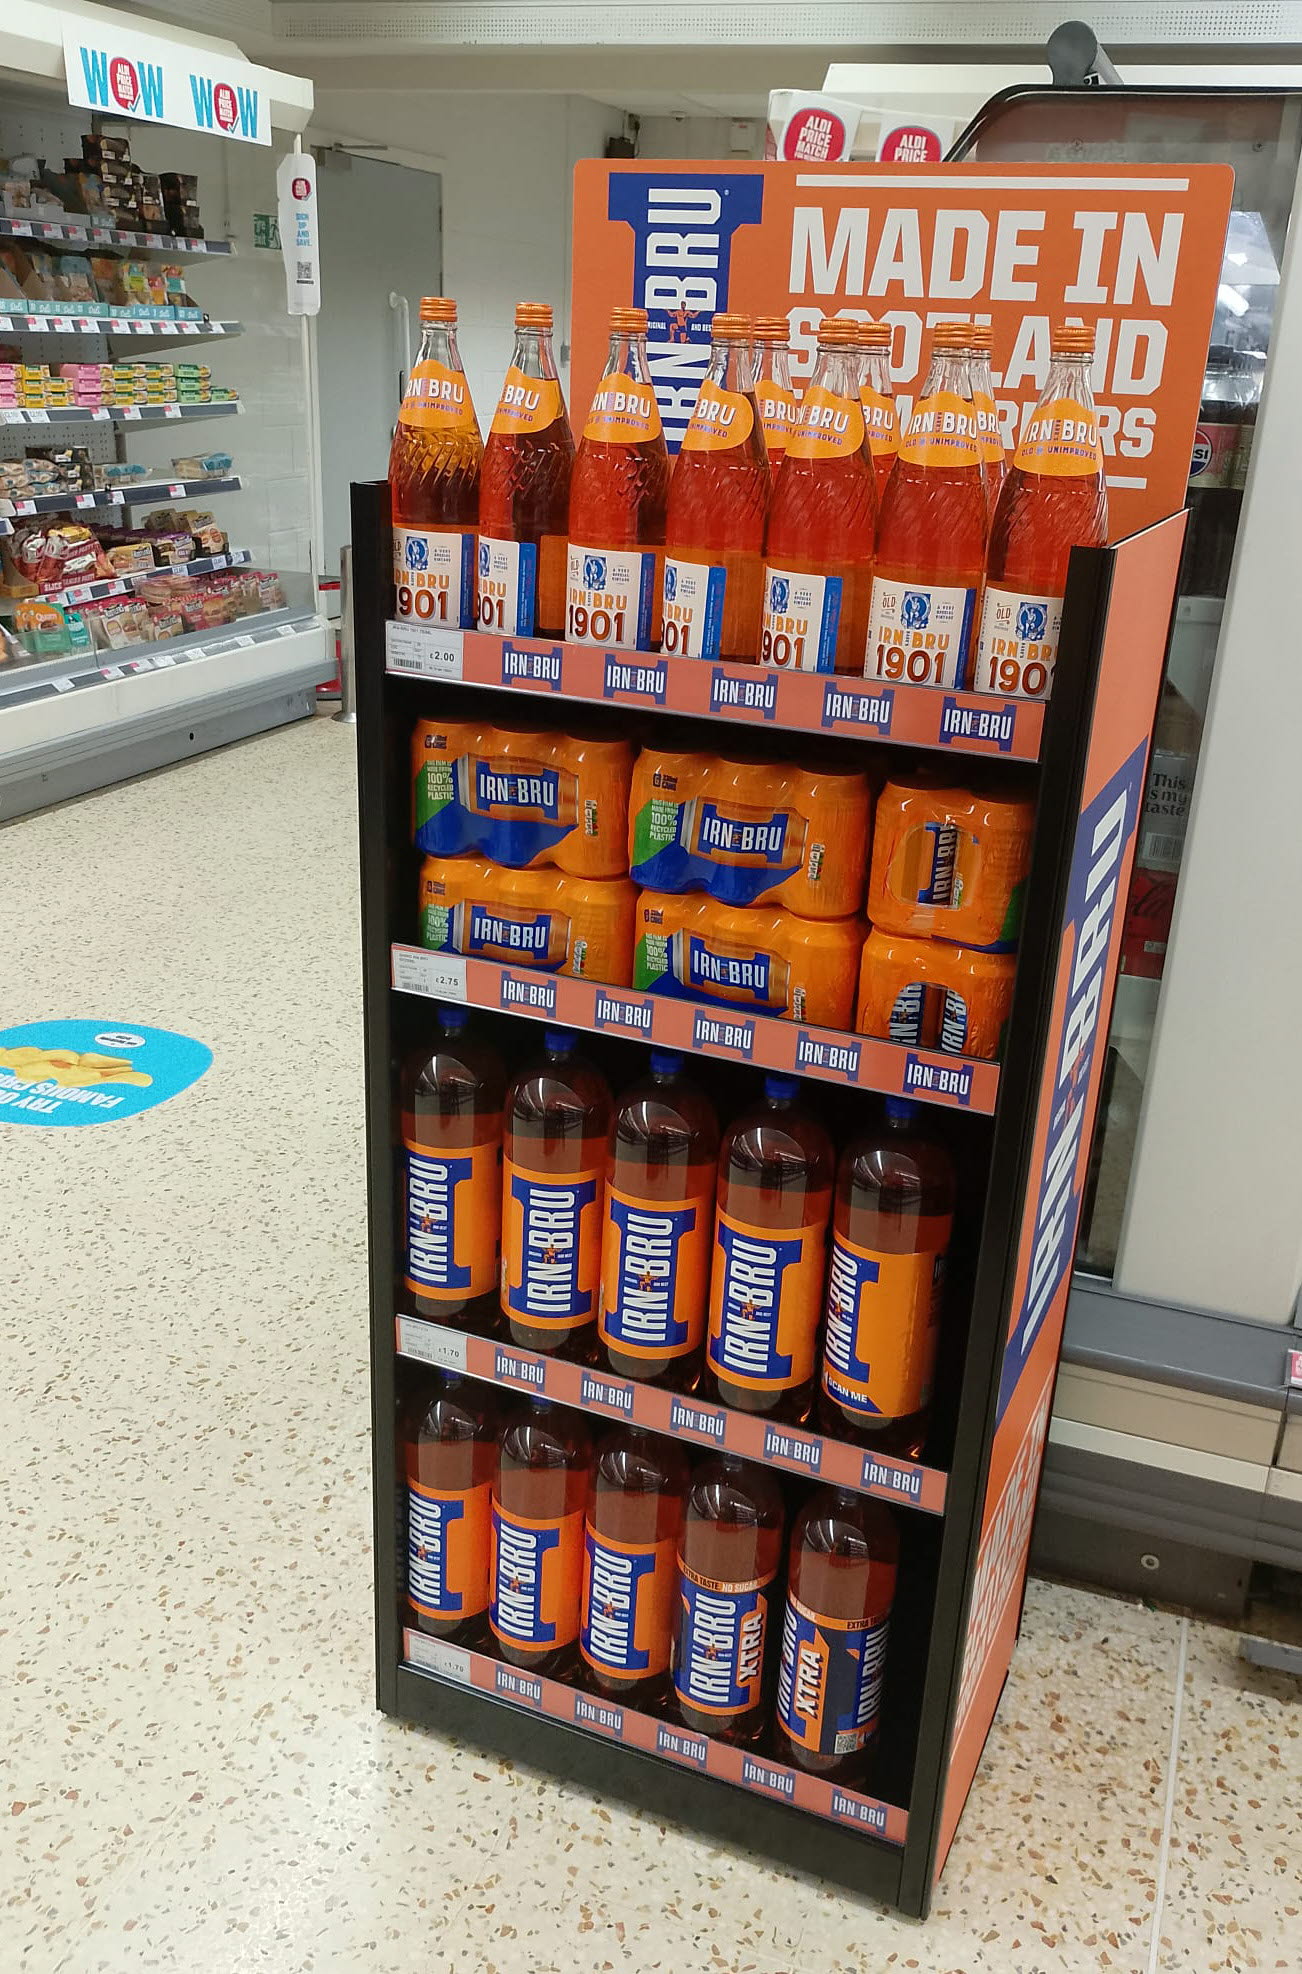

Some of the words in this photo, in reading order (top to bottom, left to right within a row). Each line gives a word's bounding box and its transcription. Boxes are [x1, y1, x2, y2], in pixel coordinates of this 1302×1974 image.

[799, 127, 833, 148] PRICE
[805, 116, 832, 133] ALDI
[796, 141, 829, 160] MATCH
[894, 147, 928, 162] PRICE
[899, 134, 927, 150] ALDI
[645, 188, 722, 311] BRU
[788, 207, 1046, 301] MADE
[1064, 211, 1185, 306] IN
[786, 307, 1168, 396] SOAND
[429, 379, 464, 403] BRU
[505, 384, 540, 410] BRU
[615, 392, 650, 418] BRU
[698, 399, 736, 426] BRU
[764, 399, 796, 424] BRU
[809, 403, 849, 433] BRU
[908, 411, 936, 436] IRN
[942, 412, 977, 440] BRU
[1025, 419, 1053, 444] IRN
[1061, 421, 1096, 447] BRU
[416, 572, 450, 589] BRU
[569, 587, 587, 606] IRN
[593, 593, 627, 610] BRU
[569, 604, 625, 642] 1901
[775, 615, 808, 636] BRU
[878, 626, 904, 646] IRN
[912, 631, 950, 651] BRU
[991, 637, 1019, 658] IRN
[429, 651, 455, 661] £2.00
[504, 652, 526, 676] IRN
[533, 655, 561, 680] BRU
[876, 644, 947, 685] 1901
[607, 665, 631, 689] IRN
[636, 670, 664, 694] BRU
[713, 679, 739, 704] IRN
[745, 683, 775, 708] BRU
[826, 693, 852, 719] IRN
[858, 697, 890, 724] BRU
[944, 708, 972, 735] IRN
[978, 712, 1012, 740] BRU
[427, 772, 454, 784] 100%
[480, 774, 509, 802] IRN
[517, 778, 554, 806] BRU
[1153, 773, 1185, 790] This
[428, 791, 455, 800] PLASTIC
[651, 811, 678, 826] 100%
[649, 831, 676, 841] PLASTIC
[703, 817, 732, 848] IRN
[741, 825, 782, 851] BRU
[474, 917, 503, 943] IRN
[509, 923, 548, 949] BRU
[435, 976, 459, 986] £2.75
[693, 950, 721, 981] IRN
[728, 961, 765, 989] BRU
[503, 980, 525, 1001] IRN
[530, 985, 554, 1008] BRU
[598, 999, 620, 1022] IRN
[626, 1005, 651, 1028] BRU
[696, 1019, 719, 1042] IRN
[724, 1026, 752, 1049] BRU
[798, 1041, 824, 1064] IRN
[829, 1048, 858, 1072] BRU
[31, 1079, 126, 1109] FAMOUS
[907, 1063, 933, 1088] IRN
[938, 1070, 970, 1096] BRU
[11, 1095, 64, 1114] TRY
[409, 1157, 449, 1221] BRU
[528, 1188, 576, 1249] BRU
[409, 1226, 448, 1283] IRN
[624, 1213, 674, 1277] BRU
[526, 1260, 573, 1312] IRN
[728, 1238, 777, 1307] BRU
[829, 1244, 858, 1314] BRU
[621, 1285, 669, 1341] IRN
[723, 1311, 771, 1373] IRN
[825, 1308, 853, 1371] IRN
[496, 1355, 516, 1377] IRN
[520, 1361, 544, 1385] BRU
[583, 1380, 604, 1401] IRN
[608, 1387, 632, 1410] BRU
[828, 1376, 850, 1397] SCAN
[850, 1390, 868, 1404] ME
[673, 1406, 695, 1428] IRN
[699, 1413, 724, 1436] BRU
[766, 1433, 790, 1457] IRN
[794, 1441, 820, 1466] BRU
[864, 1462, 888, 1485] IRN
[892, 1470, 920, 1494] BRU
[408, 1491, 442, 1554] BRU
[500, 1522, 537, 1584] BRU
[408, 1556, 441, 1606] IRN
[592, 1547, 633, 1610] BRU
[700, 1576, 719, 1591] TASTE
[722, 1583, 733, 1593] NO
[497, 1585, 535, 1637] IRN
[692, 1592, 737, 1651] BRU
[847, 1620, 869, 1630] EXTRA
[589, 1613, 629, 1665] IRN
[739, 1612, 762, 1683] XTRA
[497, 1671, 515, 1691] IRN
[519, 1678, 541, 1700] BRU
[689, 1652, 732, 1703] IRN
[795, 1647, 822, 1719] XTRA
[576, 1701, 595, 1721] IRN
[599, 1709, 621, 1729] BRU
[659, 1731, 678, 1752] IRN
[682, 1739, 706, 1761] BRU
[745, 1763, 765, 1784] IRN
[769, 1771, 793, 1794] BRU
[834, 1795, 855, 1817] IRN
[860, 1804, 885, 1828] BRU
